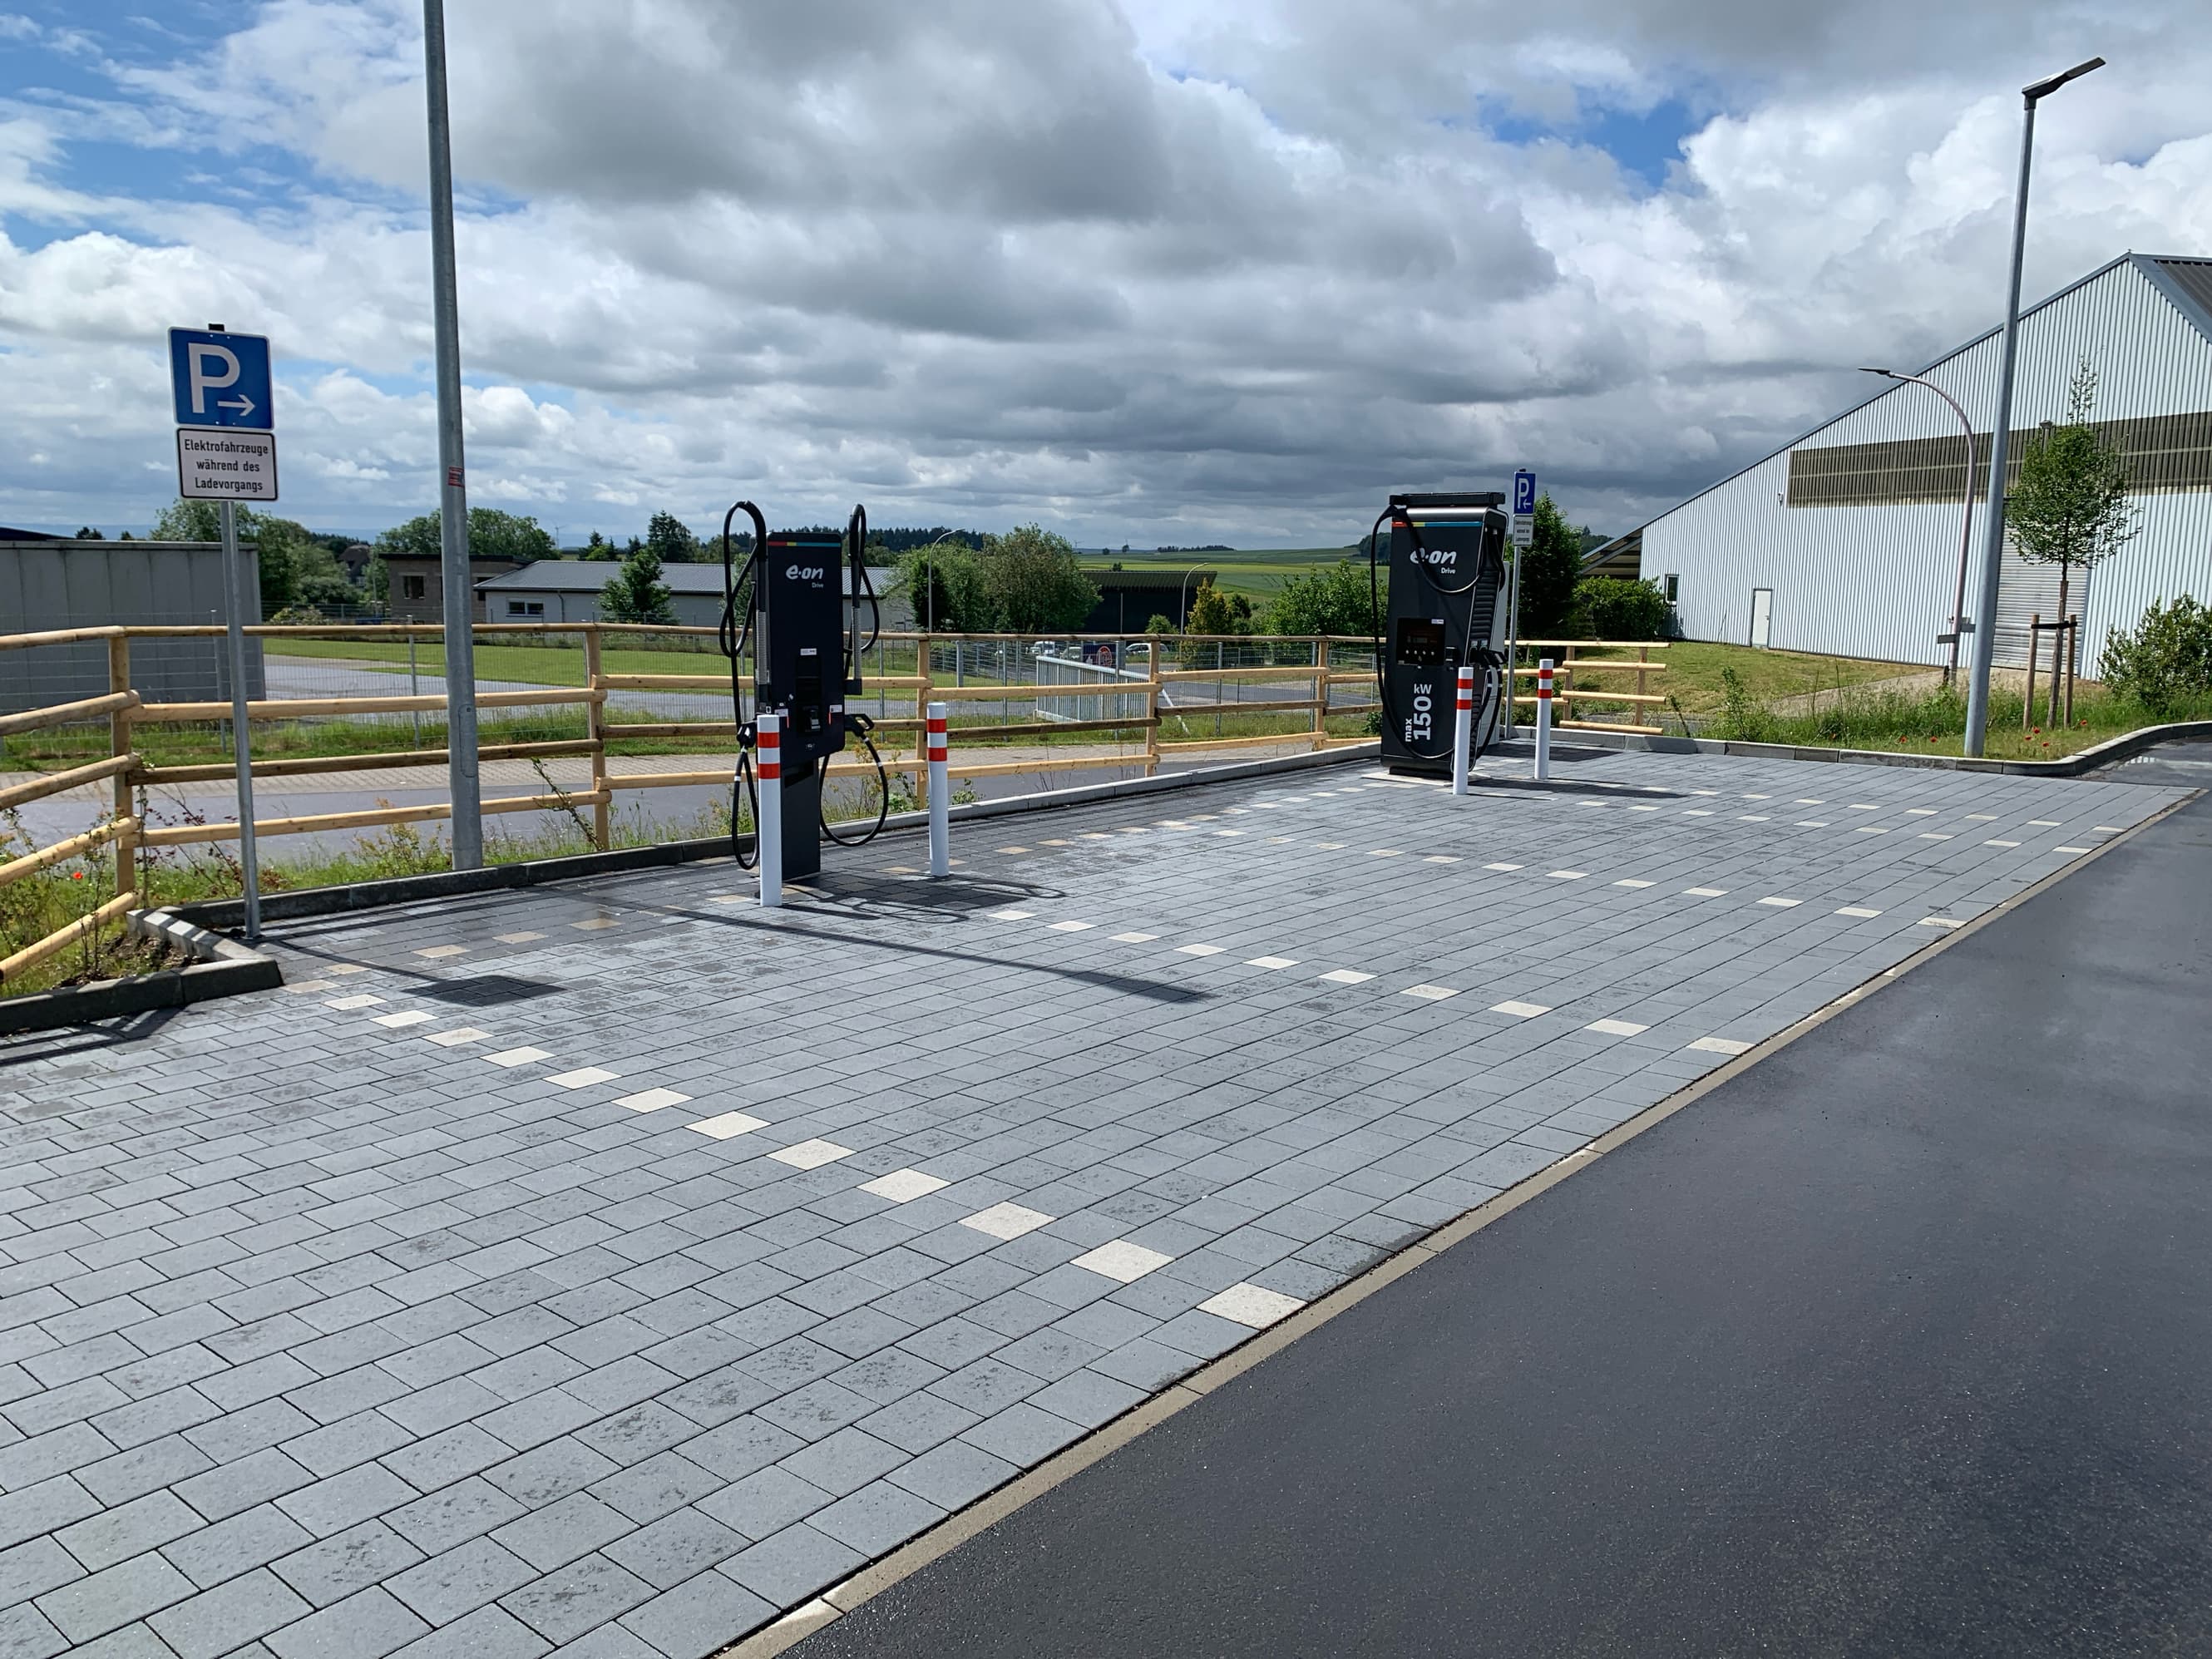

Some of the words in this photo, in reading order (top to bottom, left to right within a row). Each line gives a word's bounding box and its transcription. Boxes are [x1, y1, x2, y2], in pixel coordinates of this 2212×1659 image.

[188, 342, 240, 414] P
[184, 438, 269, 457] Elektrofahrzeuge
[196, 459, 239, 472] während
[243, 461, 260, 472] des
[195, 476, 263, 492] Ladevorgangs
[1518, 477, 1530, 509] P
[1414, 683, 1432, 694] kW
[1413, 695, 1432, 740] 150
[1405, 718, 1413, 743] max
